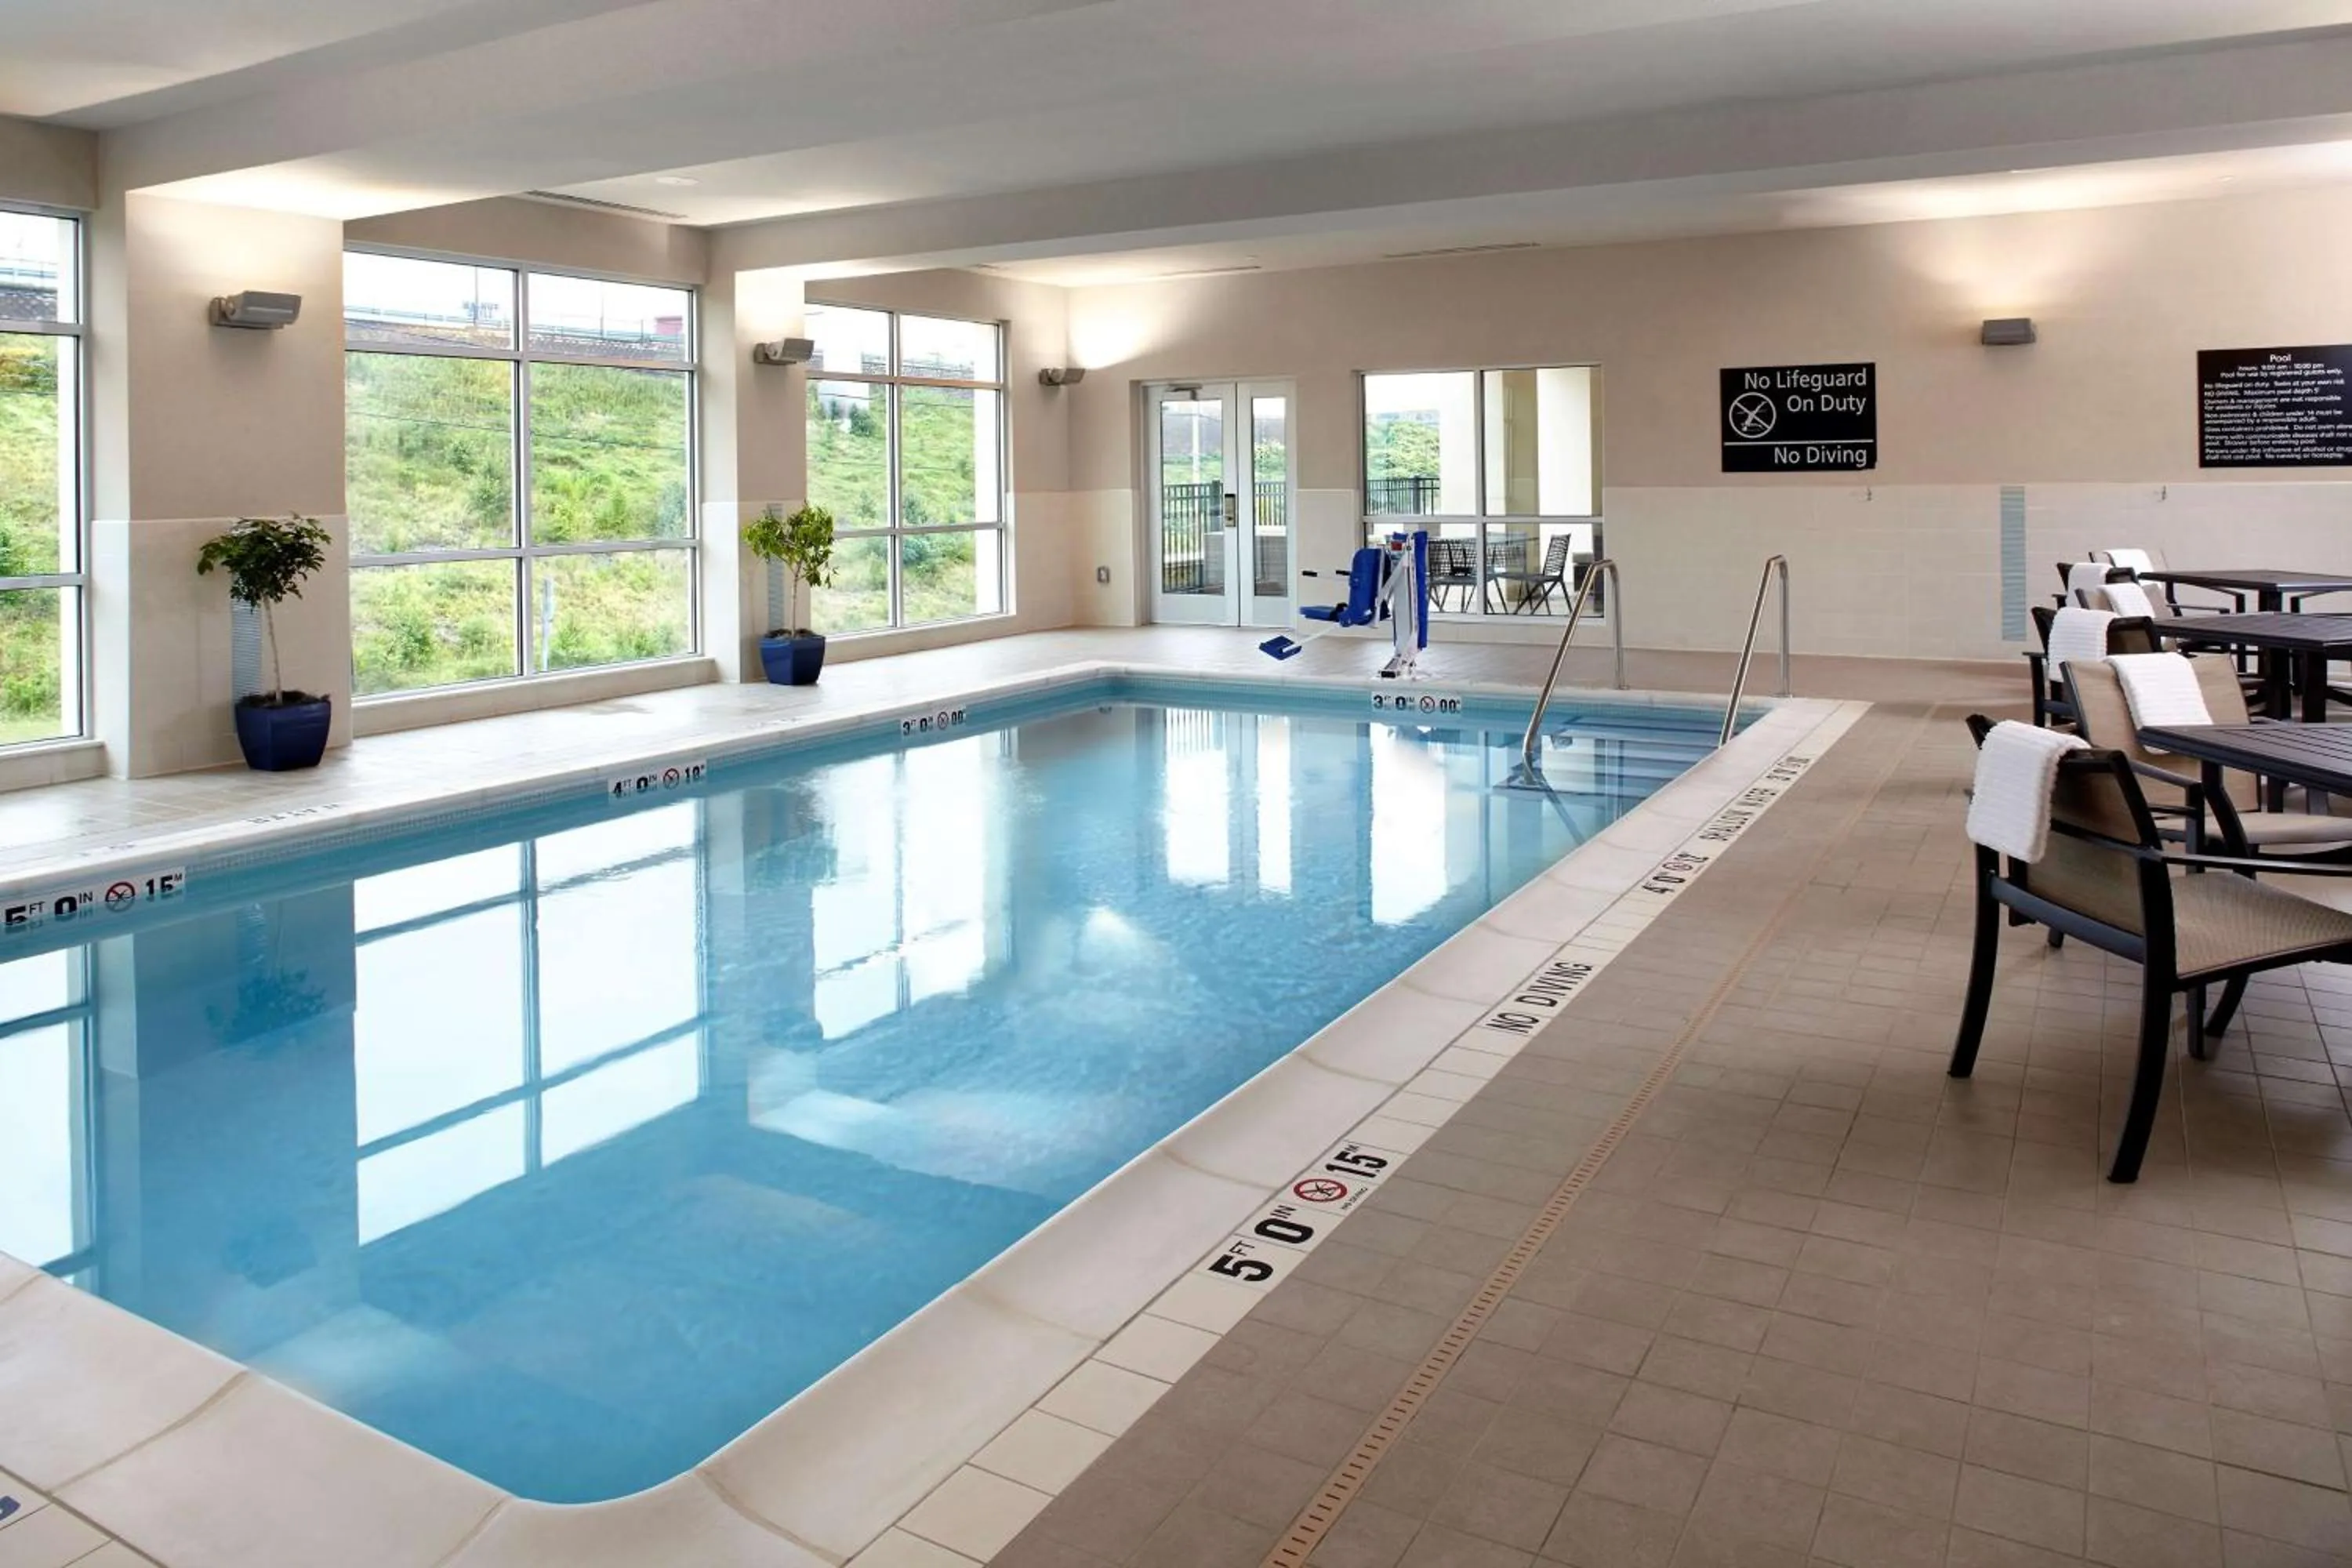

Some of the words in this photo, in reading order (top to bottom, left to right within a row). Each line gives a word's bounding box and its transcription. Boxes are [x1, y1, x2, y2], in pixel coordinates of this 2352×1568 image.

[1744, 372, 1770, 390] No
[1777, 368, 1867, 392] Lifeguard
[1787, 395, 1814, 412] On
[1821, 394, 1866, 416] Duty
[1774, 447, 1800, 464] No
[1806, 445, 1867, 467] Diving
[1486, 1012, 1540, 1034] NO
[1514, 961, 1593, 1007] DIVING
